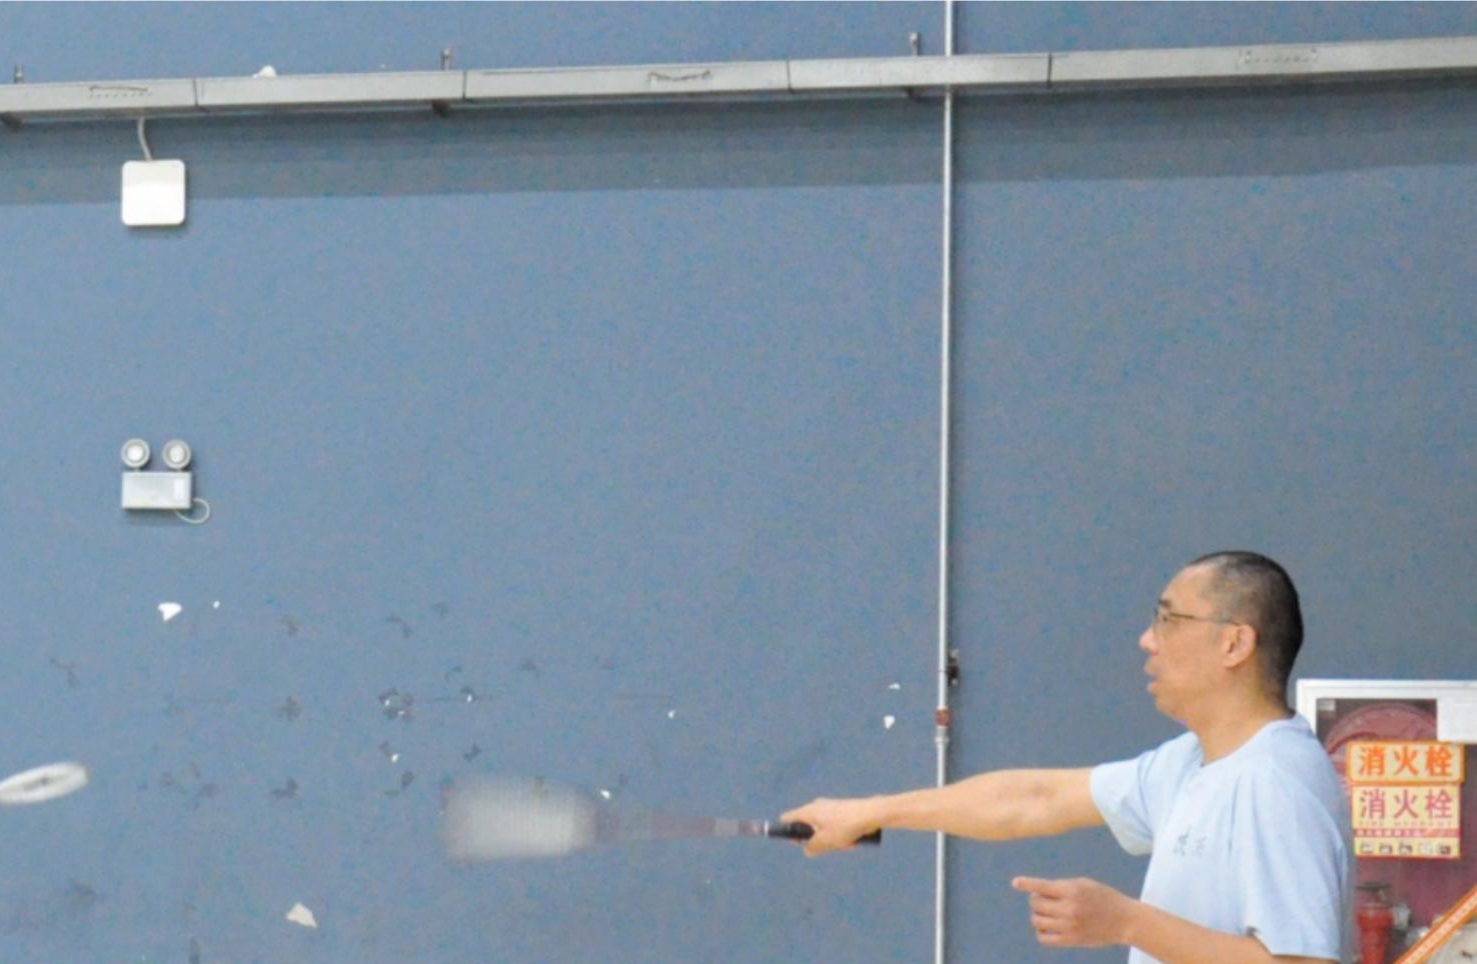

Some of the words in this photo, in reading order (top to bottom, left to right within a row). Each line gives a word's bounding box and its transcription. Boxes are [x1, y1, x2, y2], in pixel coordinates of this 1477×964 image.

[1358, 746, 1452, 776] 消火栓
[1360, 788, 1452, 818] 消火栓
